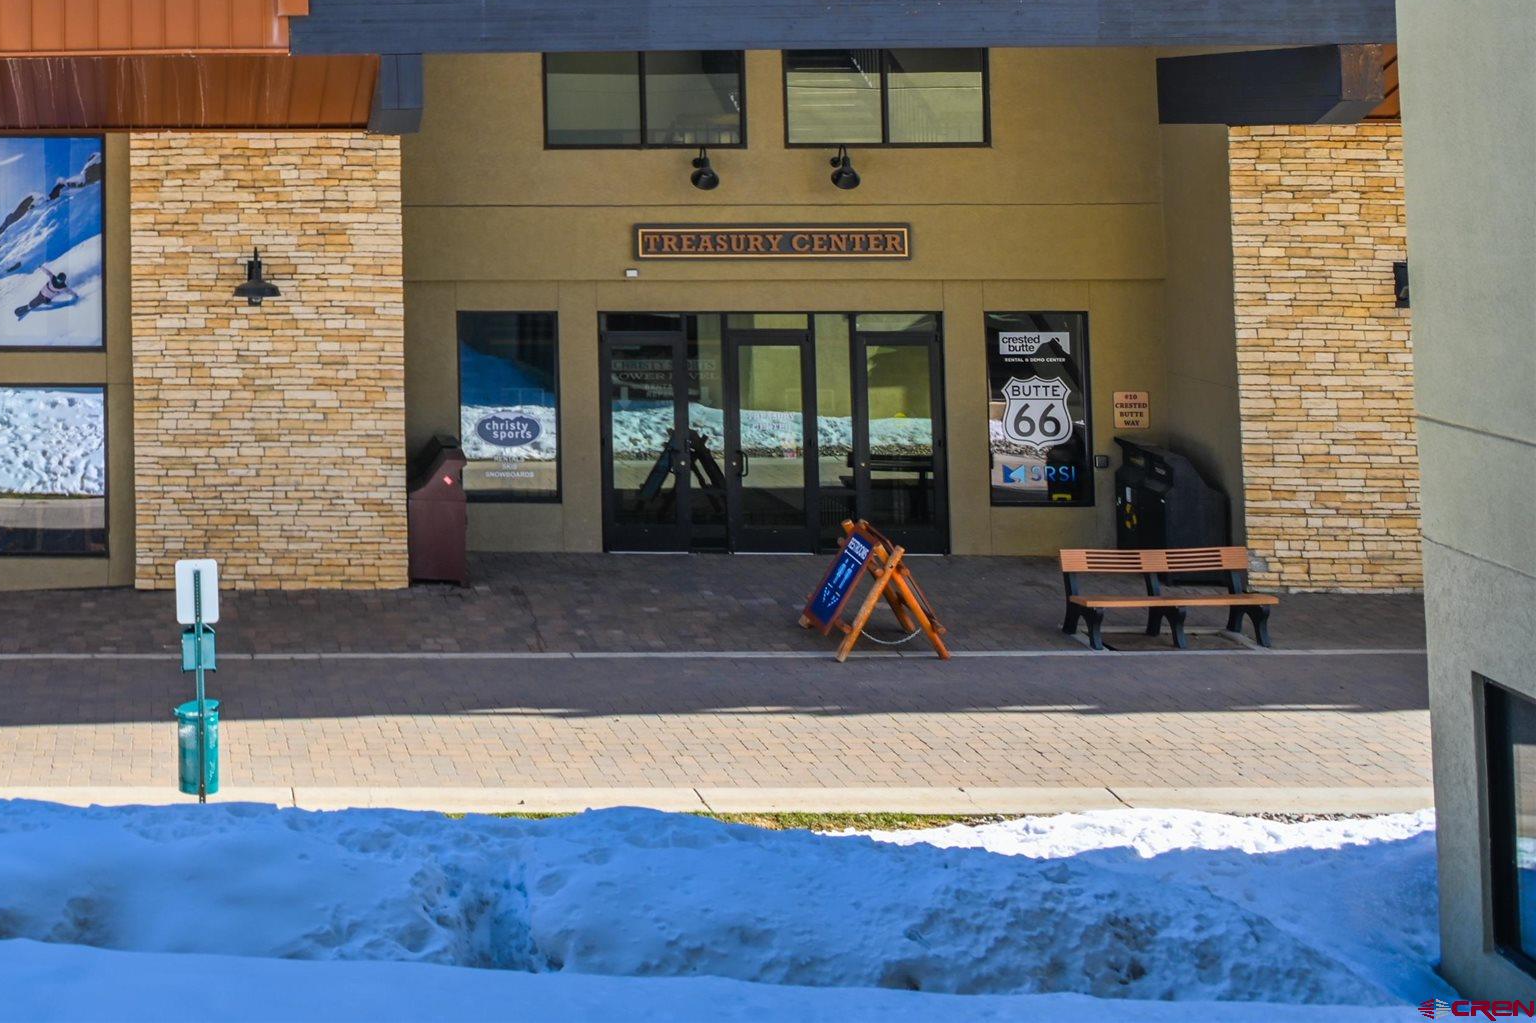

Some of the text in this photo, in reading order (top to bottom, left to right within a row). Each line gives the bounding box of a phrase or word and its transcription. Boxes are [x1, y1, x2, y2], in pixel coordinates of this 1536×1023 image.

[644, 234, 903, 252] TREASURY CENTER
[1002, 335, 1040, 344] crested
[1008, 344, 1035, 352] butte
[1011, 385, 1061, 396] BUTTE
[1013, 403, 1061, 437] 66
[485, 420, 528, 432] christy
[492, 430, 532, 441] sports
[1031, 465, 1076, 482] SRSI
